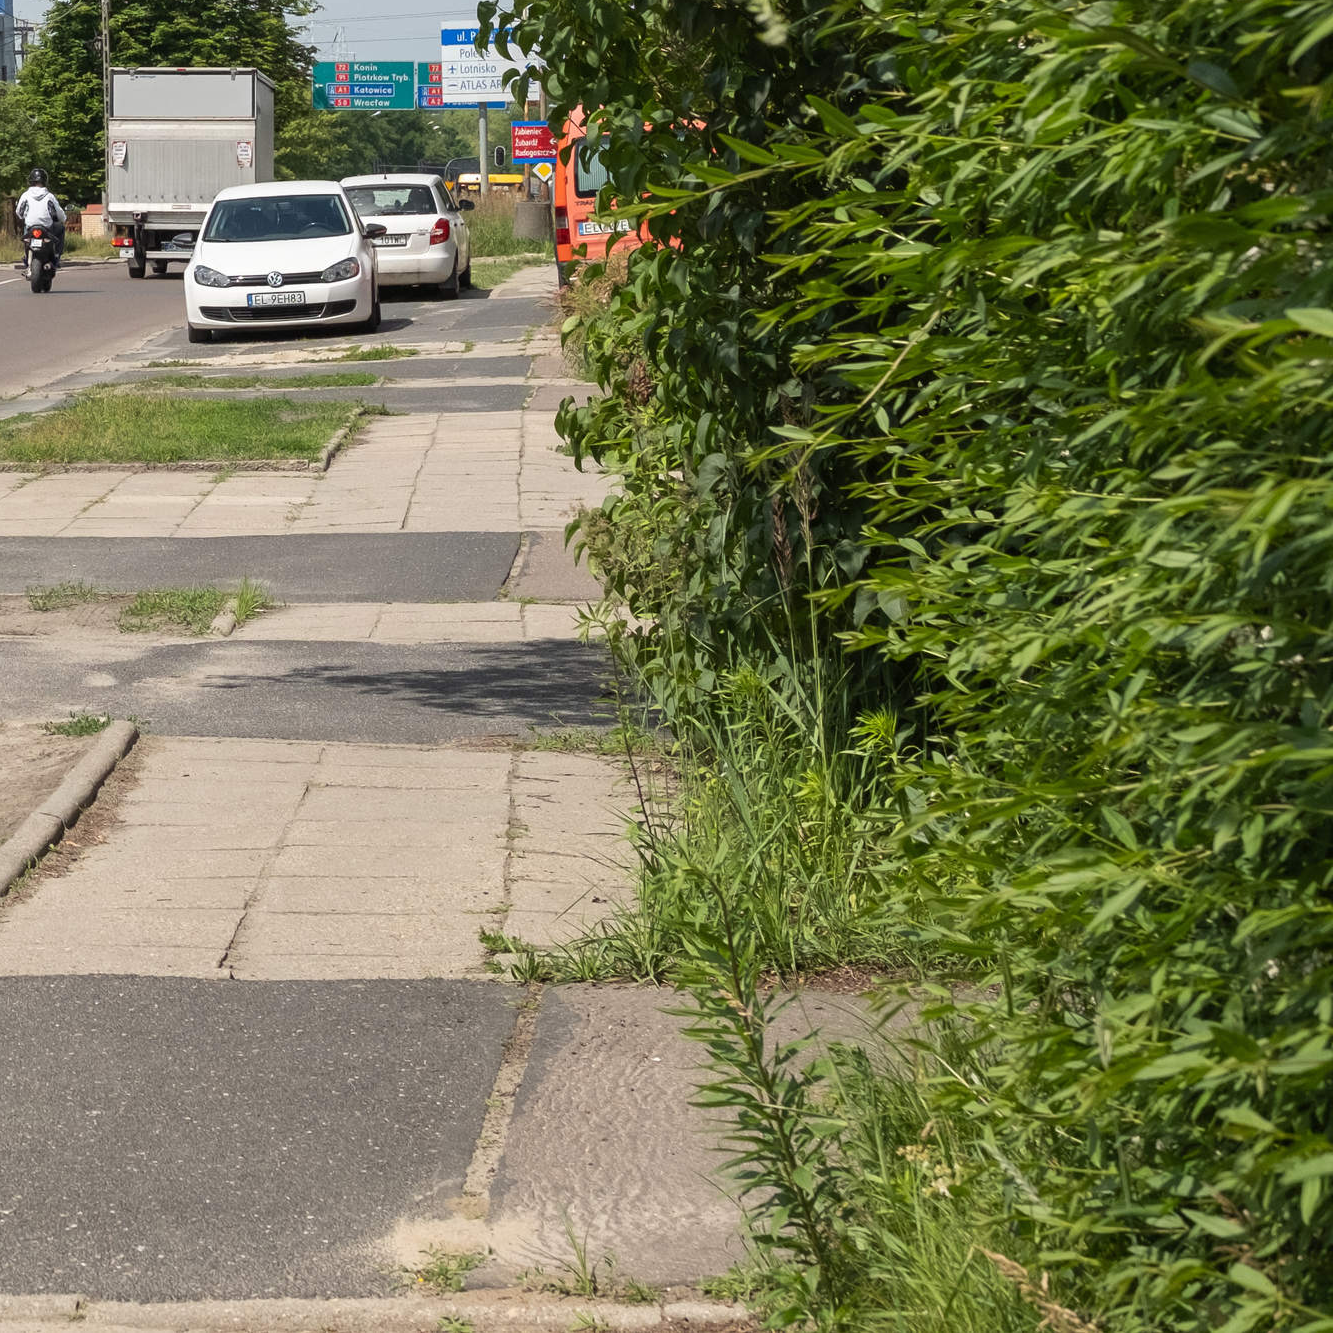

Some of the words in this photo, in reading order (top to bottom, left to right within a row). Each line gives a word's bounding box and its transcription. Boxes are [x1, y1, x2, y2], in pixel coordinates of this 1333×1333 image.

[456, 31, 467, 42] ul.
[459, 48, 491, 59] Polee
[354, 63, 378, 72] Konin
[459, 63, 497, 74] Lotnisko
[354, 86, 392, 94] Katowice
[460, 79, 488, 90] ATLAS
[255, 295, 267, 305] EL
[271, 293, 302, 304] 9EH83
